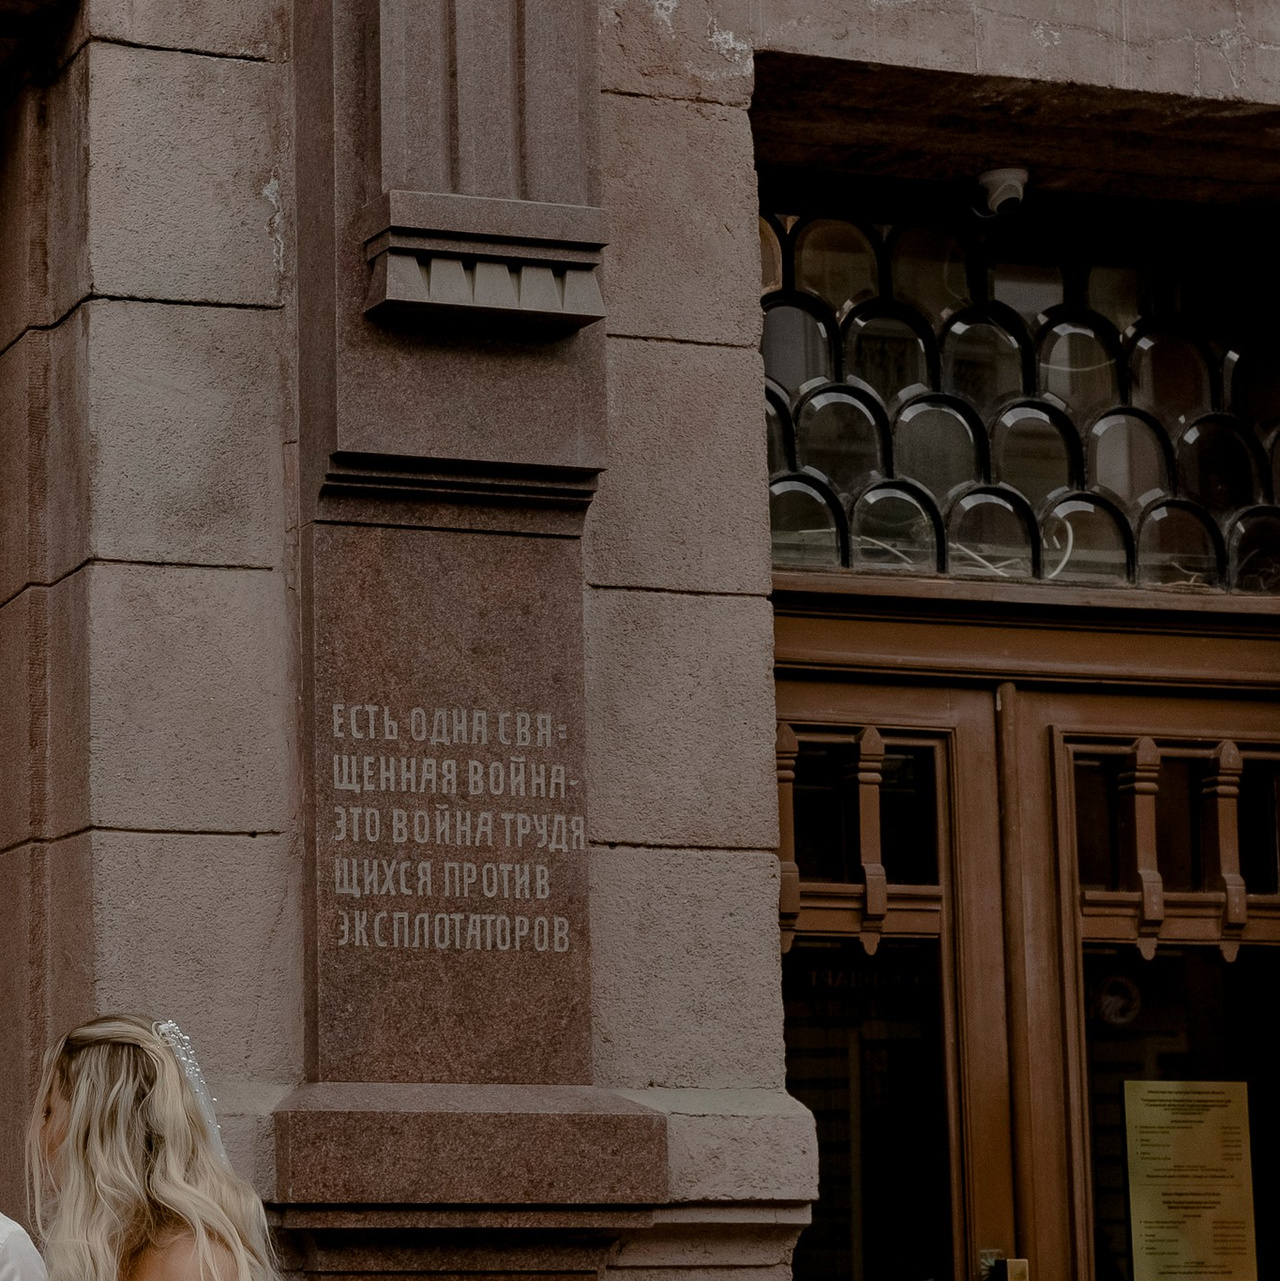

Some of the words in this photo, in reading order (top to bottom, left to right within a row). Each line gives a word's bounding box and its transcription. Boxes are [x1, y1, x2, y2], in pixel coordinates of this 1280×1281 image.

[332, 704, 398, 740] ЕСТЬ
[410, 707, 488, 745] ОДНА
[333, 754, 457, 794] ЩЕННАЯ
[333, 806, 381, 842] ЭТО
[392, 803, 493, 847] ВОЙНА
[501, 811, 585, 852] ТРУДЯ
[334, 858, 432, 898] ЩИХСЯ
[444, 861, 550, 899] ПРОТИВ
[337, 910, 570, 952] ЭКСПЛОТАТОРОВ
